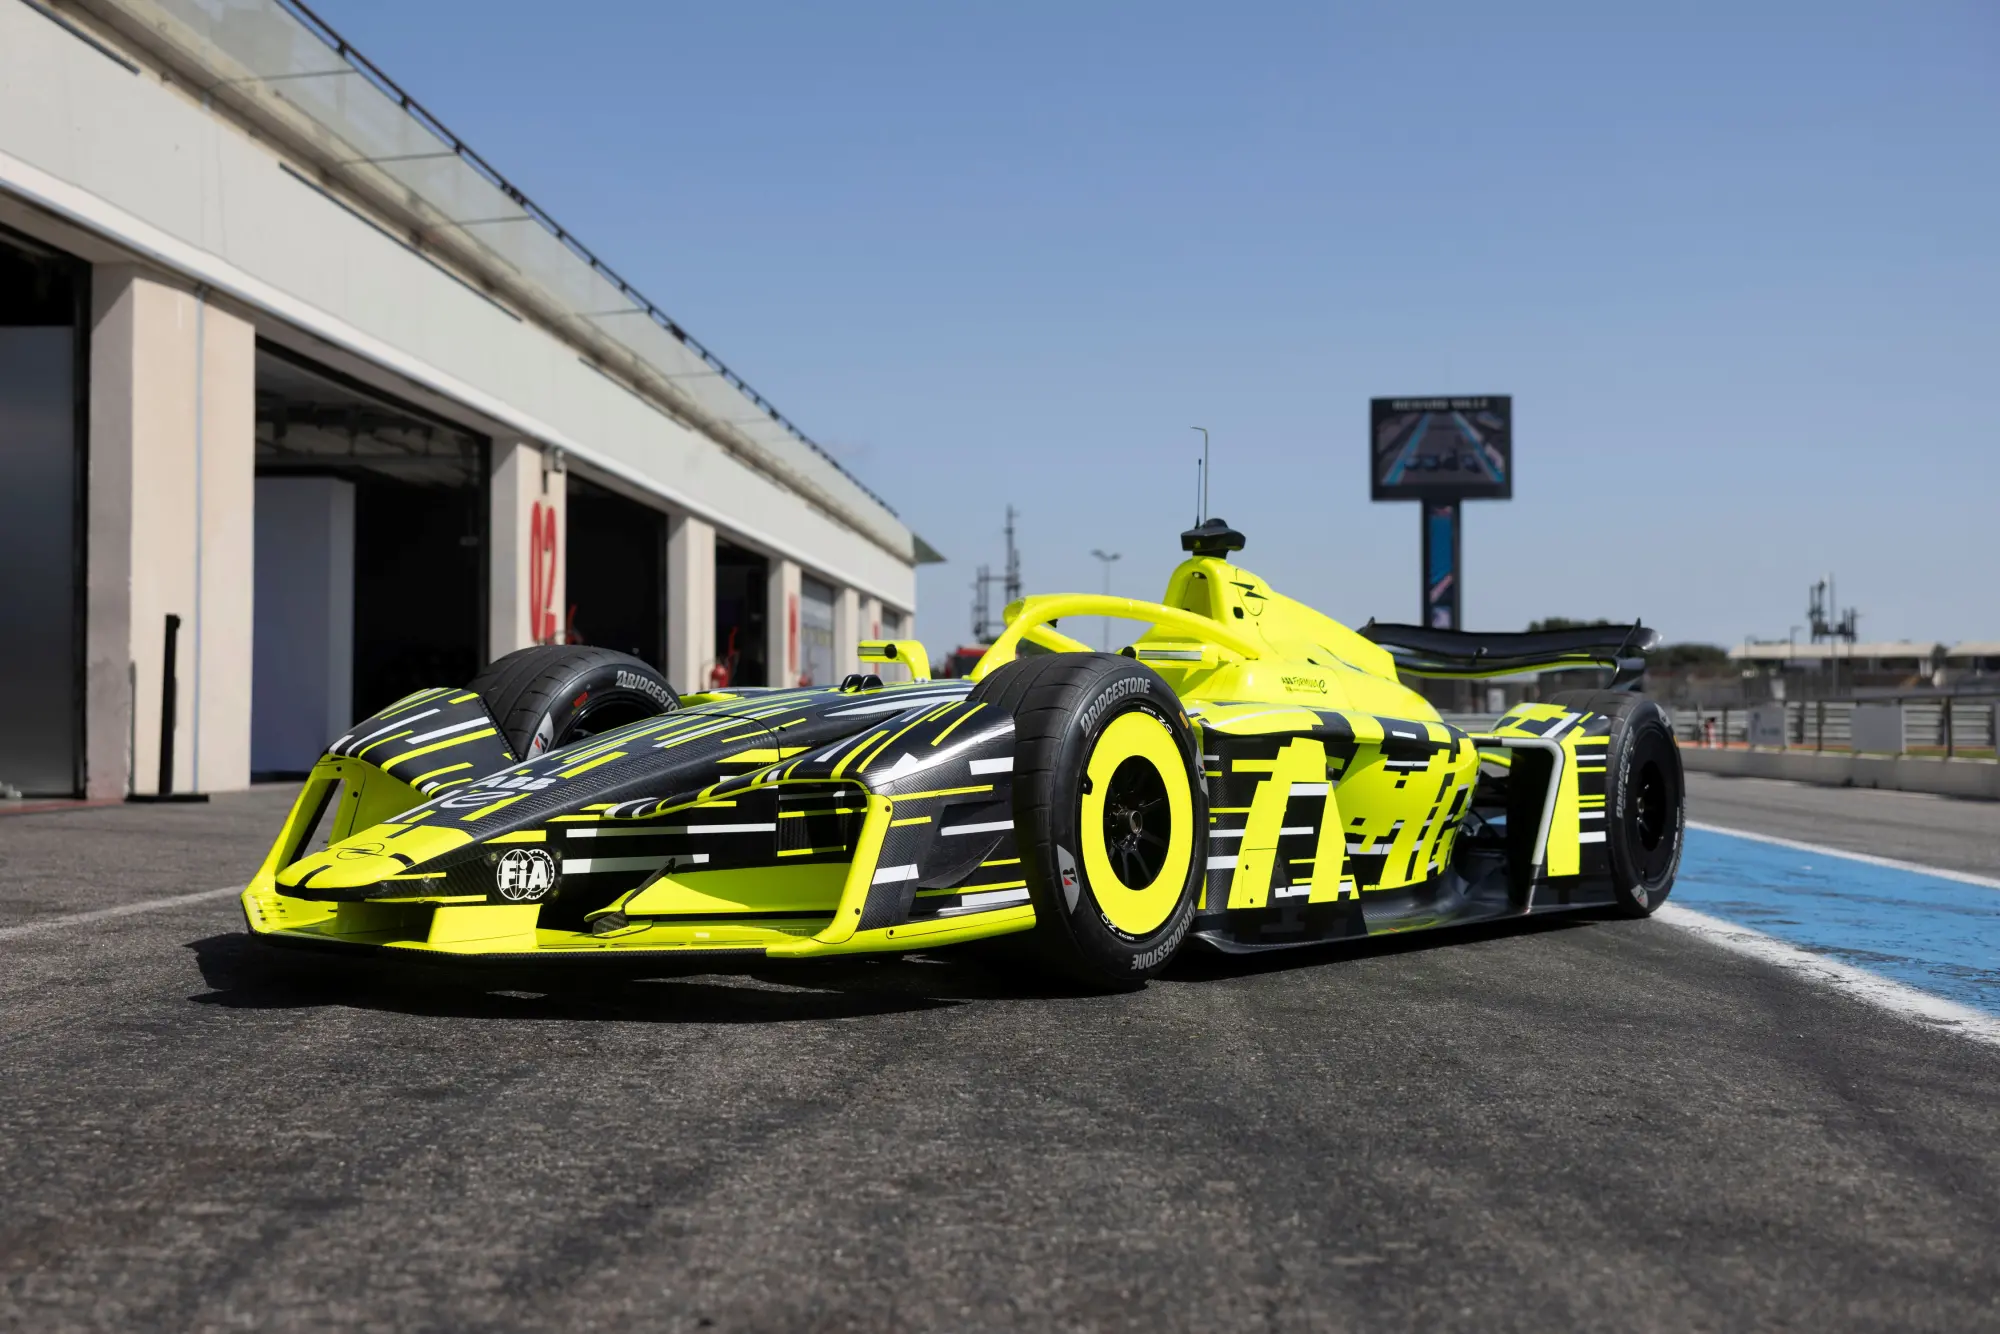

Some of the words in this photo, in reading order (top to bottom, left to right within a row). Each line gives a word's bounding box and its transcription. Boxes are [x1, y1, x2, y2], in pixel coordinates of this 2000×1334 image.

[529, 499, 557, 644] 02
[1080, 677, 1151, 737] BRIDGESTONE
[467, 776, 557, 790] ABB
[1130, 899, 1197, 970] BRIDGESTONE
